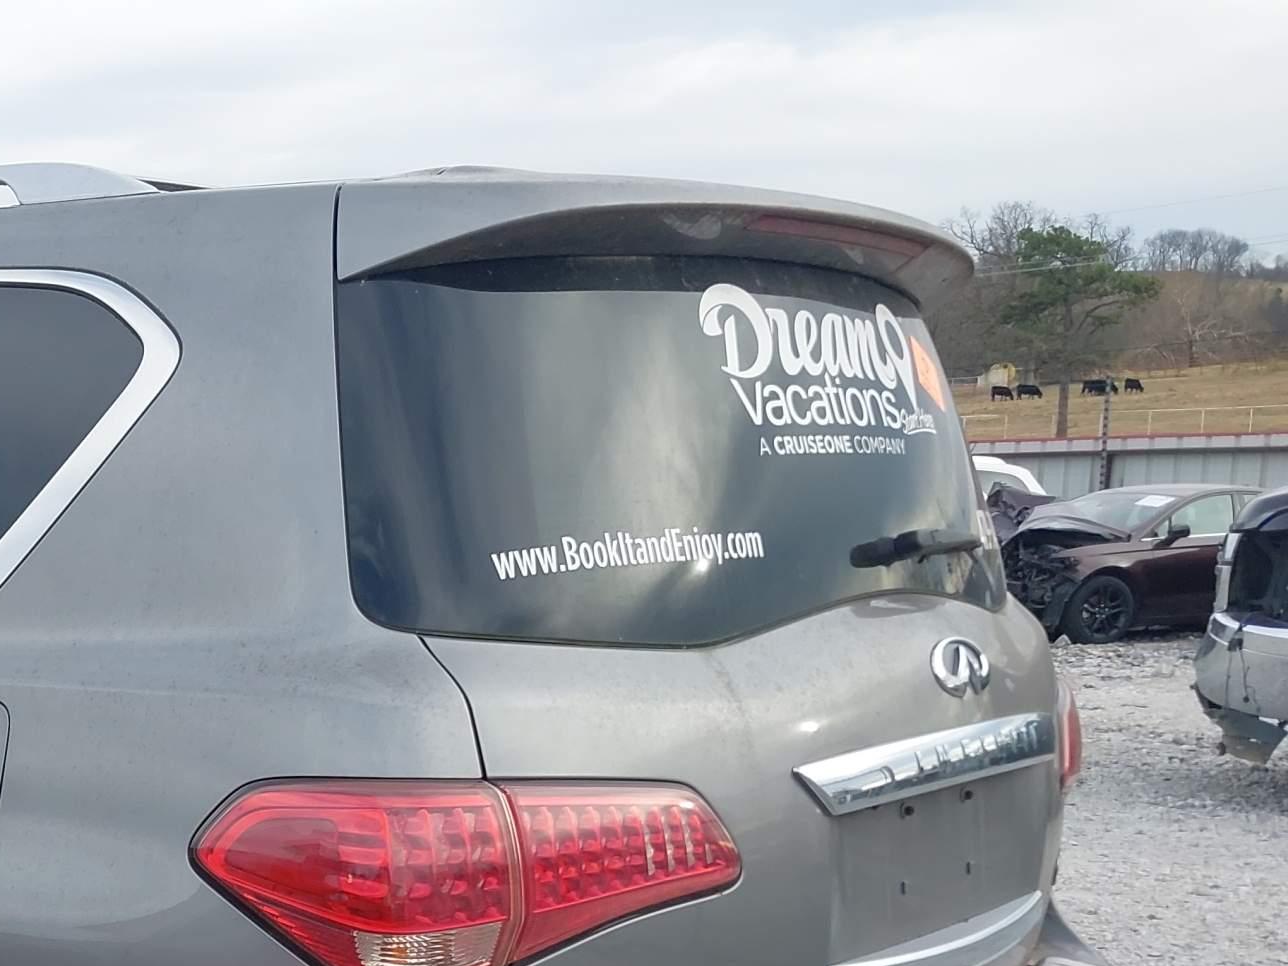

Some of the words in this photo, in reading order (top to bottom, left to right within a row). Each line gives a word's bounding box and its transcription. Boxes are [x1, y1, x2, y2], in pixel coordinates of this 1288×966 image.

[699, 283, 916, 398] Dream
[730, 374, 902, 429] Vacations
[760, 437, 772, 456] A
[774, 435, 853, 455] CRUISEONE
[854, 437, 905, 455] COMPANY
[491, 527, 764, 580] www.BookItandEnjoy.com
